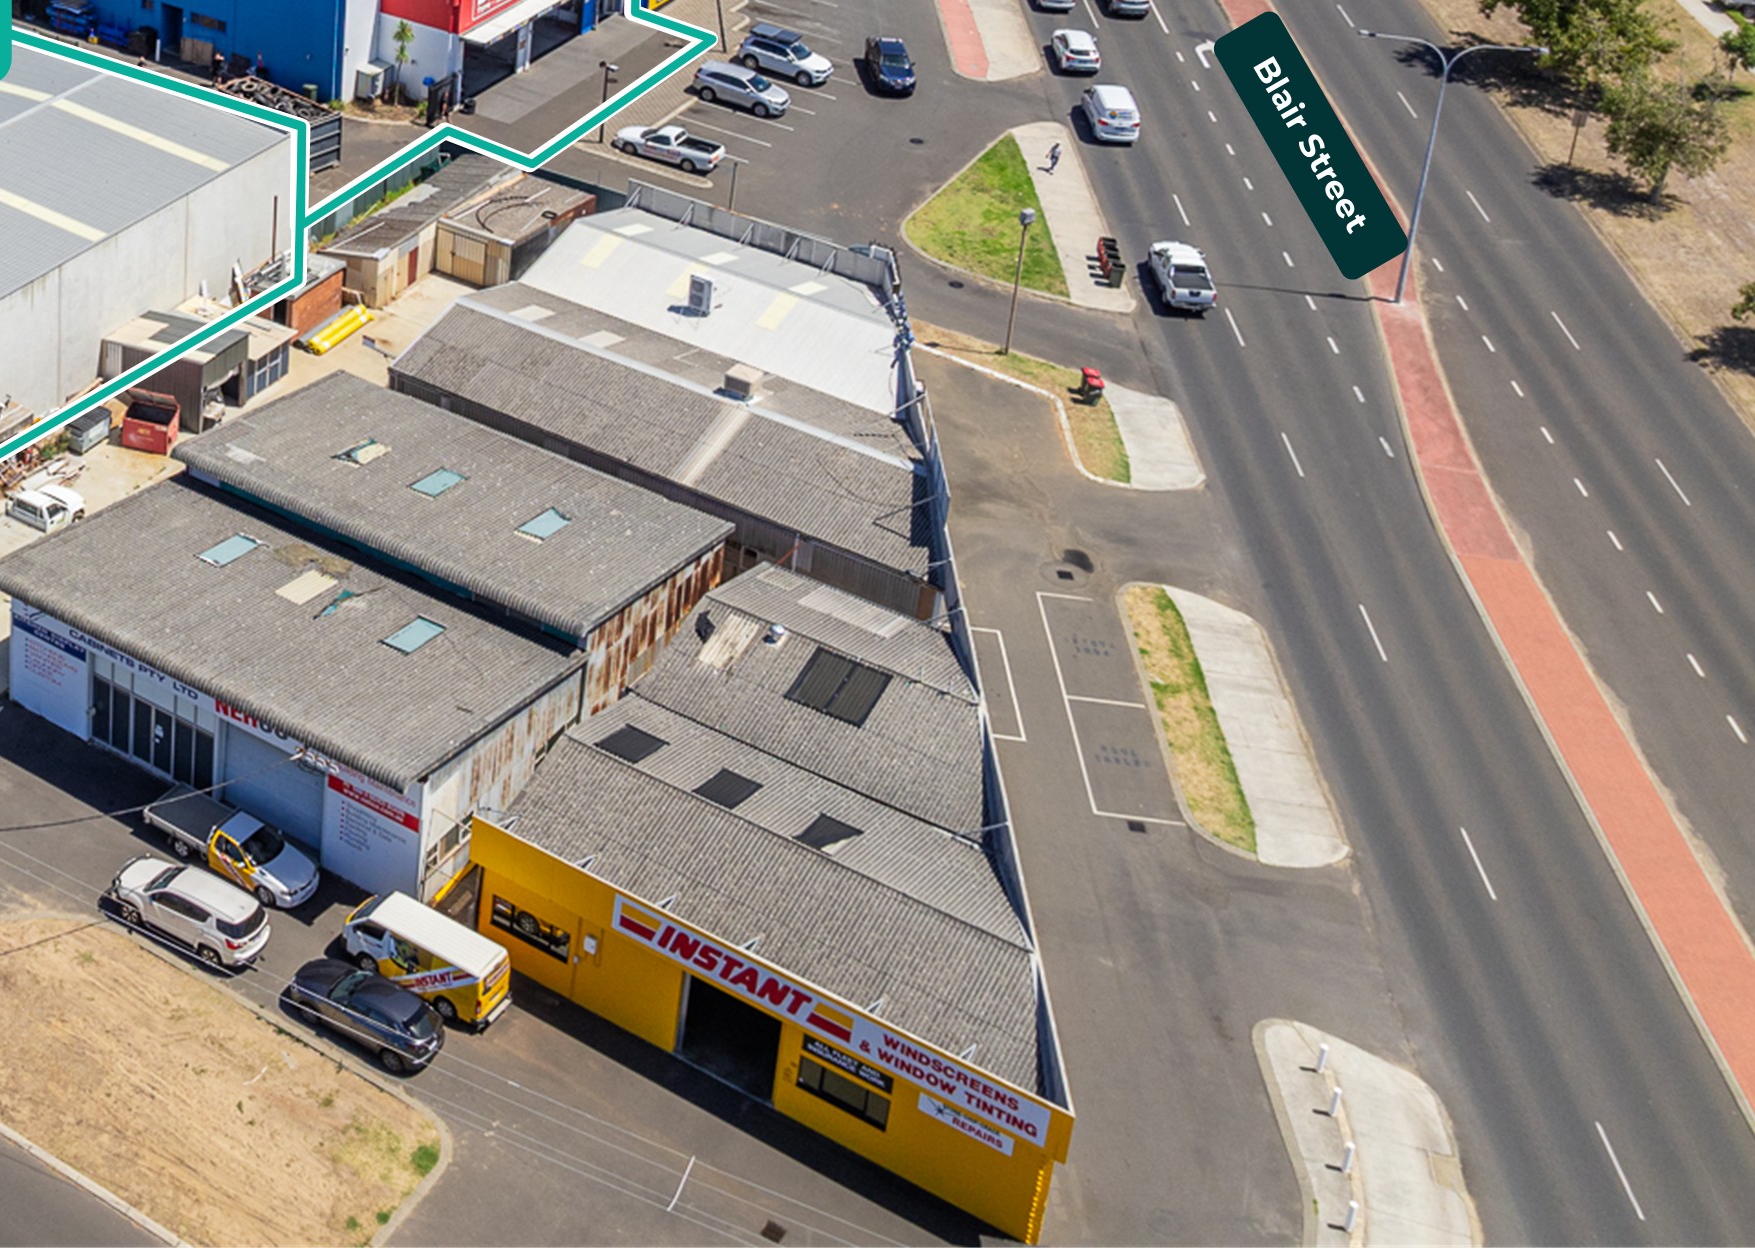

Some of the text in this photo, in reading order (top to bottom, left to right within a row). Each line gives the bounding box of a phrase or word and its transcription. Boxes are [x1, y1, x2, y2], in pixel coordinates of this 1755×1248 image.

[68, 628, 200, 701] CABINETS PTY LTD
[413, 971, 452, 986] INSTANT
[656, 924, 813, 1016] INSTANT
[858, 1039, 1039, 1140] & WINDOW TINTING
[882, 1032, 1020, 1113] WINDSCREENS
[951, 1115, 1004, 1149] REPAIRS
